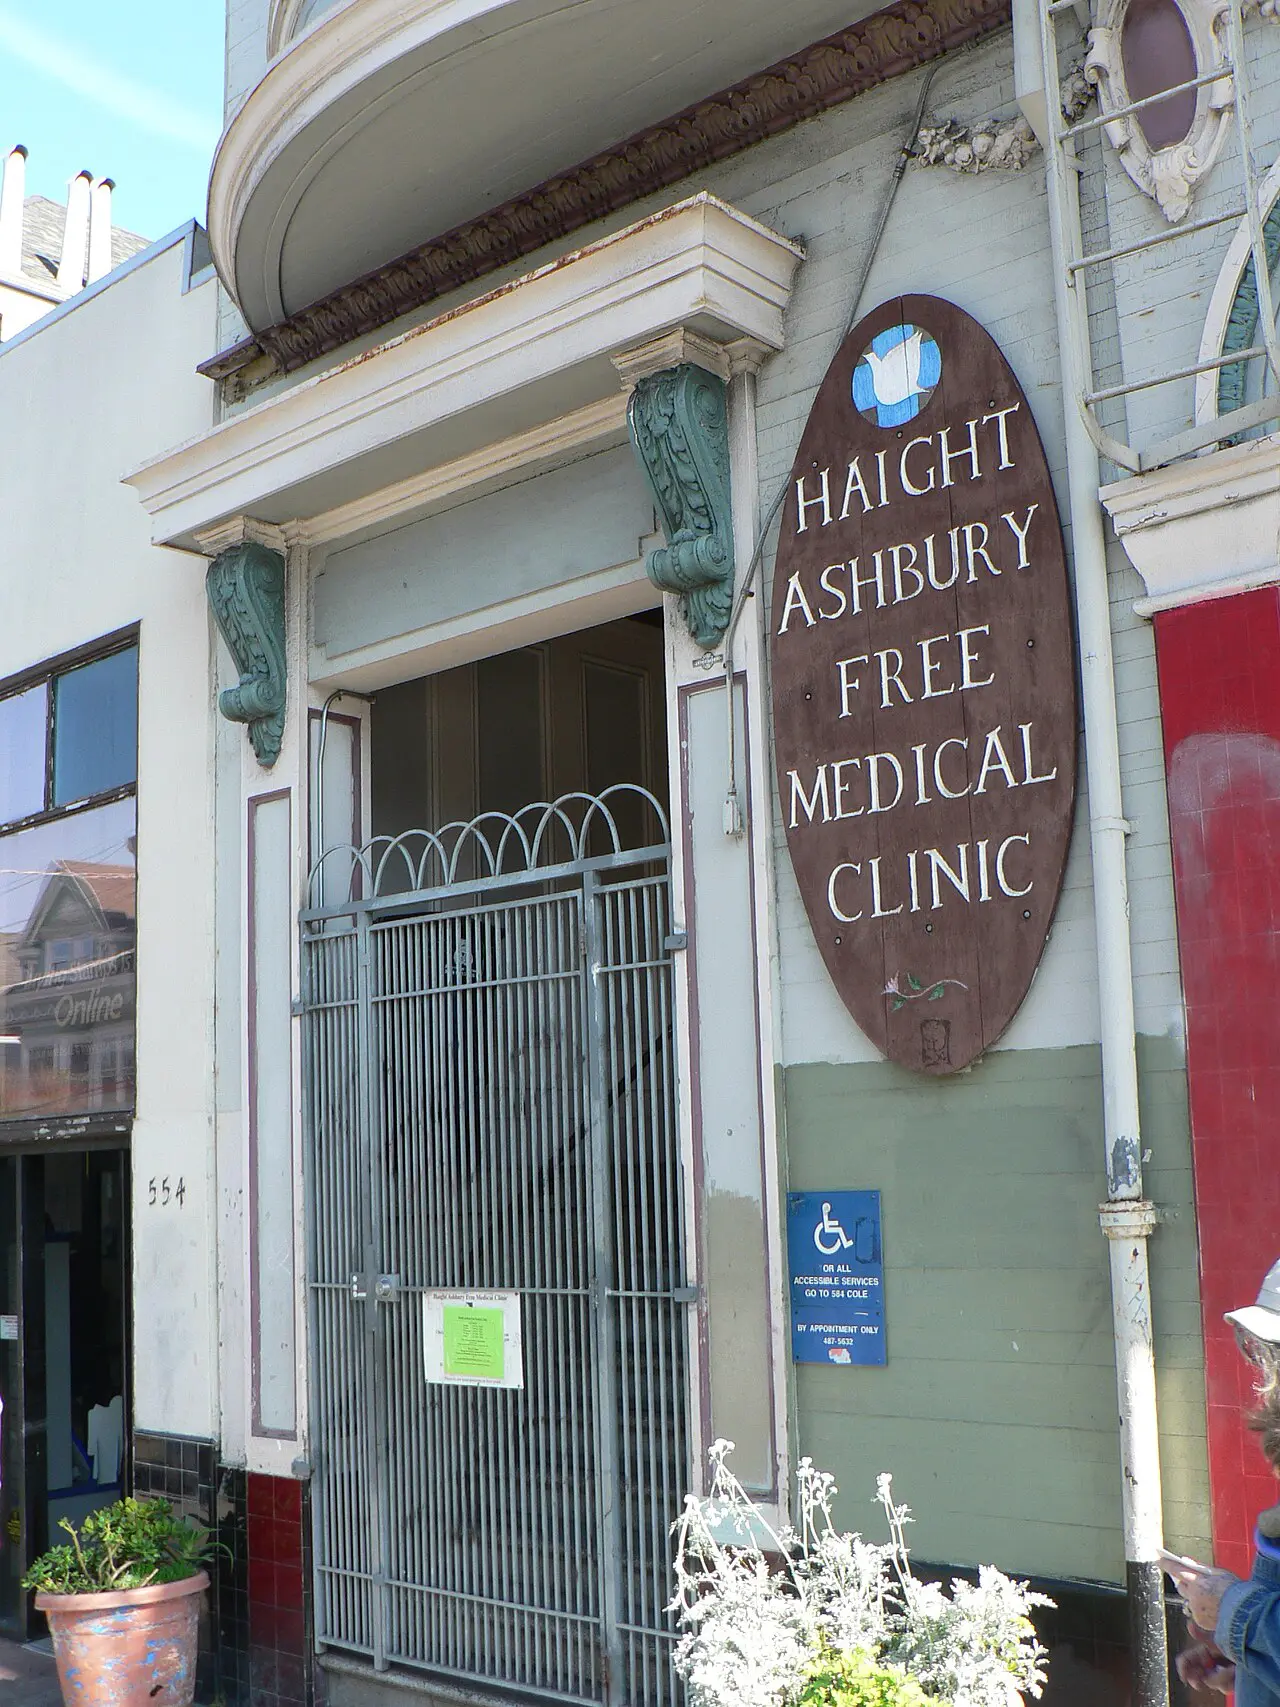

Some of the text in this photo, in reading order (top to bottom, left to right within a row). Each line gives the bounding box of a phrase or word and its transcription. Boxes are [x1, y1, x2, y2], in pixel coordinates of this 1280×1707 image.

[796, 402, 1020, 534] HAIGHT
[777, 503, 1039, 636] ASHBURY
[836, 624, 995, 719] FREE
[786, 722, 1058, 829] MEDICAL
[827, 832, 1033, 923] CLINIC
[54, 988, 124, 1027] Online
[148, 1176, 186, 1208] 554
[793, 1276, 879, 1286] ACCESSIBLE SERVICES
[836, 1264, 852, 1273] ALL
[805, 1289, 817, 1297] GO
[819, 1289, 829, 1298] TO
[846, 1290, 868, 1298] COLE
[797, 1324, 879, 1334] BY APPOINTMENT ONLY
